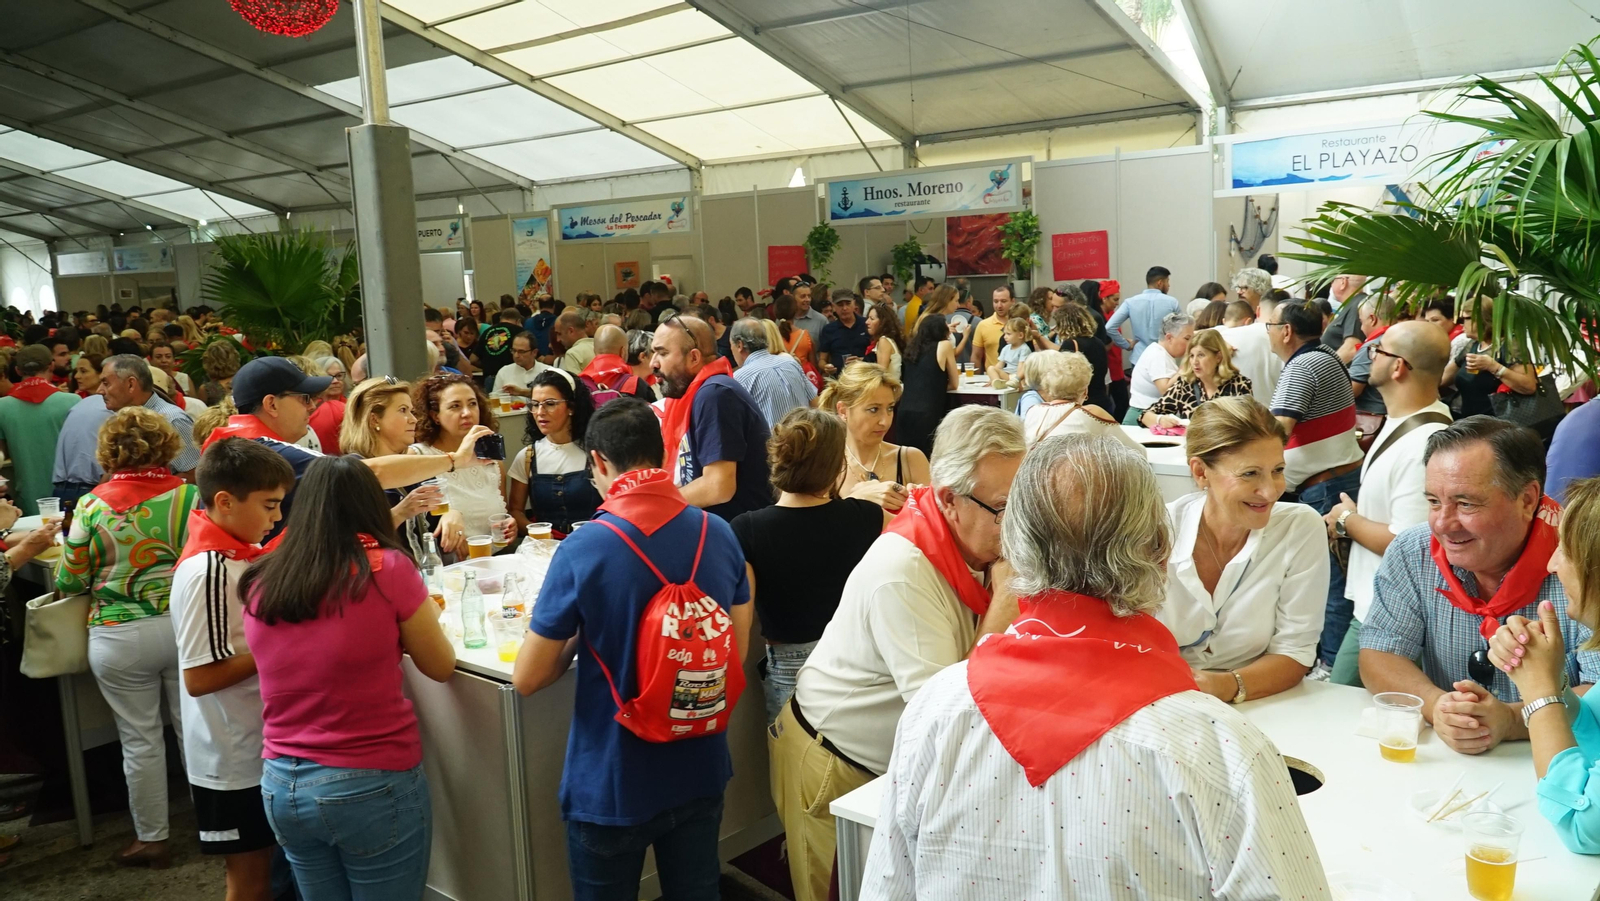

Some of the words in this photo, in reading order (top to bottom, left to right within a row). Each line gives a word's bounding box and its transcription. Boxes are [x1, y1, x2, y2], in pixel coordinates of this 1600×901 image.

[1321, 134, 1387, 148] Restaurante
[1292, 154, 1312, 172] EL
[1319, 144, 1418, 169] PLAYAZO
[863, 186, 903, 201] Hnos.
[907, 181, 963, 197] Moreno
[894, 199, 931, 208] restaurante
[609, 213, 623, 224] del
[625, 211, 662, 222] Pescador
[418, 228, 443, 237] PUERTO
[667, 648, 693, 666] edp
[679, 680, 708, 688] Rock
